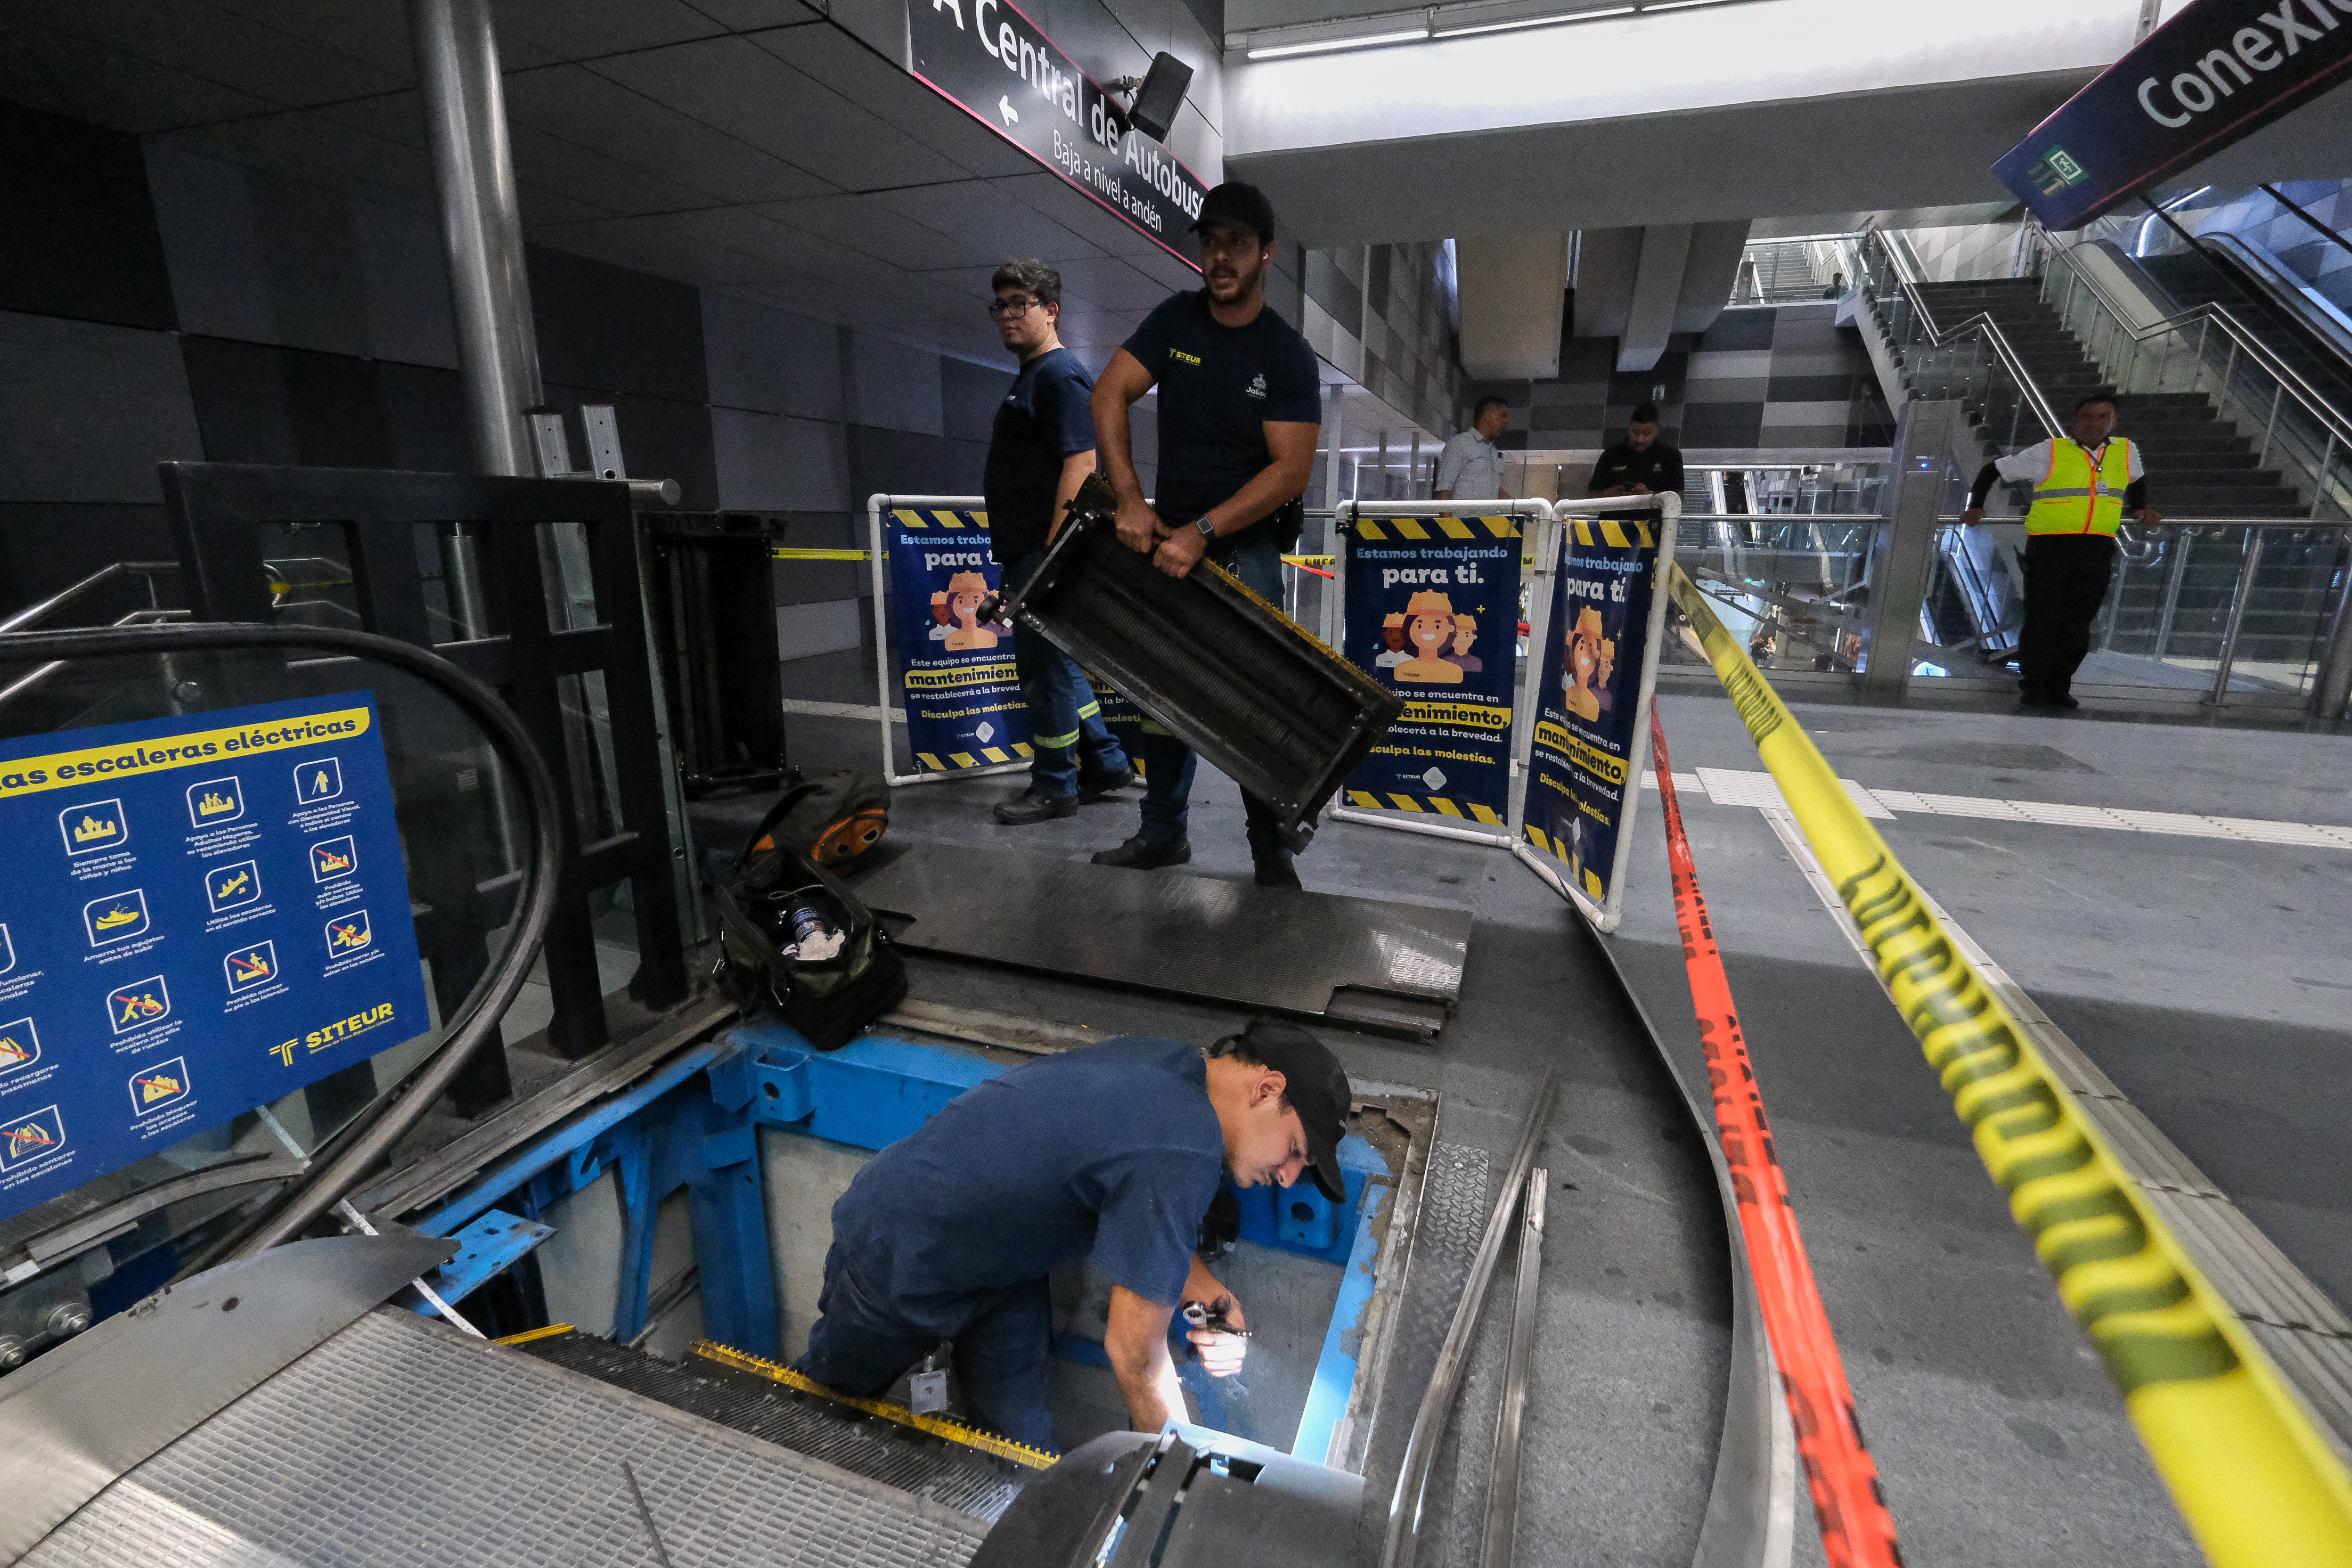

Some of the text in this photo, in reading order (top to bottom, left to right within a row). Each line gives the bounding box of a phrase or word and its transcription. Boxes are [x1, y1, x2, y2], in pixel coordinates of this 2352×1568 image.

[2137, 0, 2352, 128] Conexi
[976, 0, 1204, 220] Central de Autobus
[1054, 129, 1162, 233] Baja a nivel a andén
[1176, 352, 1201, 364] SITEUR
[900, 534, 991, 544] Estamos traba
[925, 553, 982, 570] para
[1357, 548, 1417, 559] Estamos
[1420, 546, 1507, 561] trabajando
[1382, 562, 1484, 588] para ti.
[1567, 577, 1626, 603] para ti.
[933, 658, 959, 667] equipo
[971, 654, 1016, 662] encuentra
[909, 666, 1018, 685] mantenimien
[922, 688, 975, 699] restablecerá
[992, 683, 1020, 693] breved
[1428, 691, 1484, 701] encuentra
[921, 709, 965, 719] Disculpa
[982, 701, 1029, 713] molestias.
[1102, 714, 1141, 723] molesti
[1400, 704, 1508, 728] enimiento,
[1452, 729, 1502, 742] brevedad.
[1545, 707, 1620, 752] Este se encuentra en
[0, 720, 356, 790] as escaleras eléctricas
[1370, 745, 1496, 764] sculpa las molestias.
[1538, 726, 1624, 785] mantnimiento,
[1540, 772, 1570, 797] Disculpa
[1579, 771, 1586, 783] la
[1587, 775, 1619, 801] brevedad.
[73, 856, 108, 867] Siempre
[241, 904, 272, 916] escaleras
[248, 909, 276, 919] correcto
[84, 949, 116, 961] Amarra
[99, 954, 121, 963] antes
[306, 1002, 394, 1048] SITEUR
[110, 1033, 146, 1048] Prohibido
[147, 1023, 173, 1035] utilizar
[116, 1038, 149, 1052] escalera
[10, 1064, 59, 1084] recargarse
[0, 1073, 52, 1096] pasamanos
[158, 1110, 187, 1125] accesos
[160, 1114, 195, 1131] escaleras
[0, 1150, 75, 1183] rohibido sentarse
[30, 1158, 72, 1178] escalones
